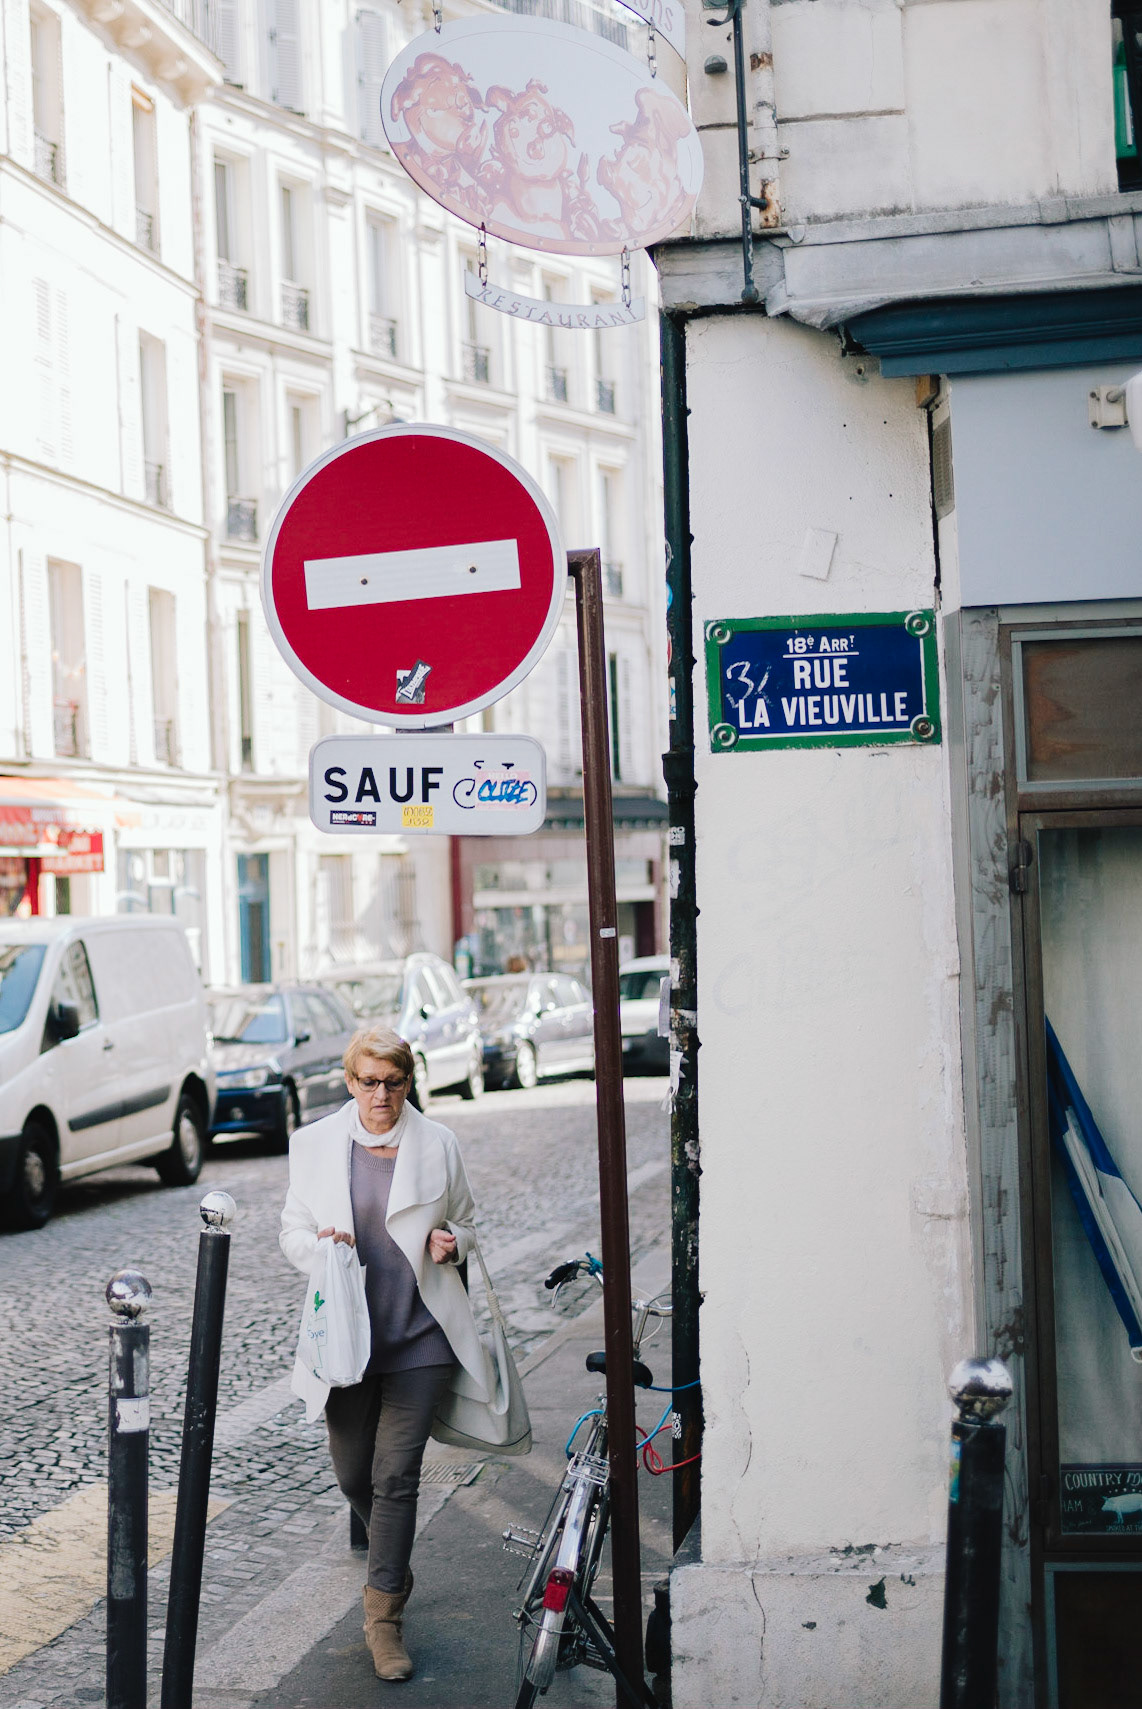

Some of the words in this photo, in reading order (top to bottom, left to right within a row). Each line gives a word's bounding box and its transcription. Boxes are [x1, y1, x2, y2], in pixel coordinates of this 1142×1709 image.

[476, 287, 637, 328] RESTAURANT
[793, 658, 850, 690] RUE
[738, 697, 771, 729] LA
[781, 691, 909, 727] VIEUVILLE
[323, 766, 444, 804] SAUF
[1065, 1472, 1122, 1491] COUNTRY
[1126, 1472, 1142, 1487] M
